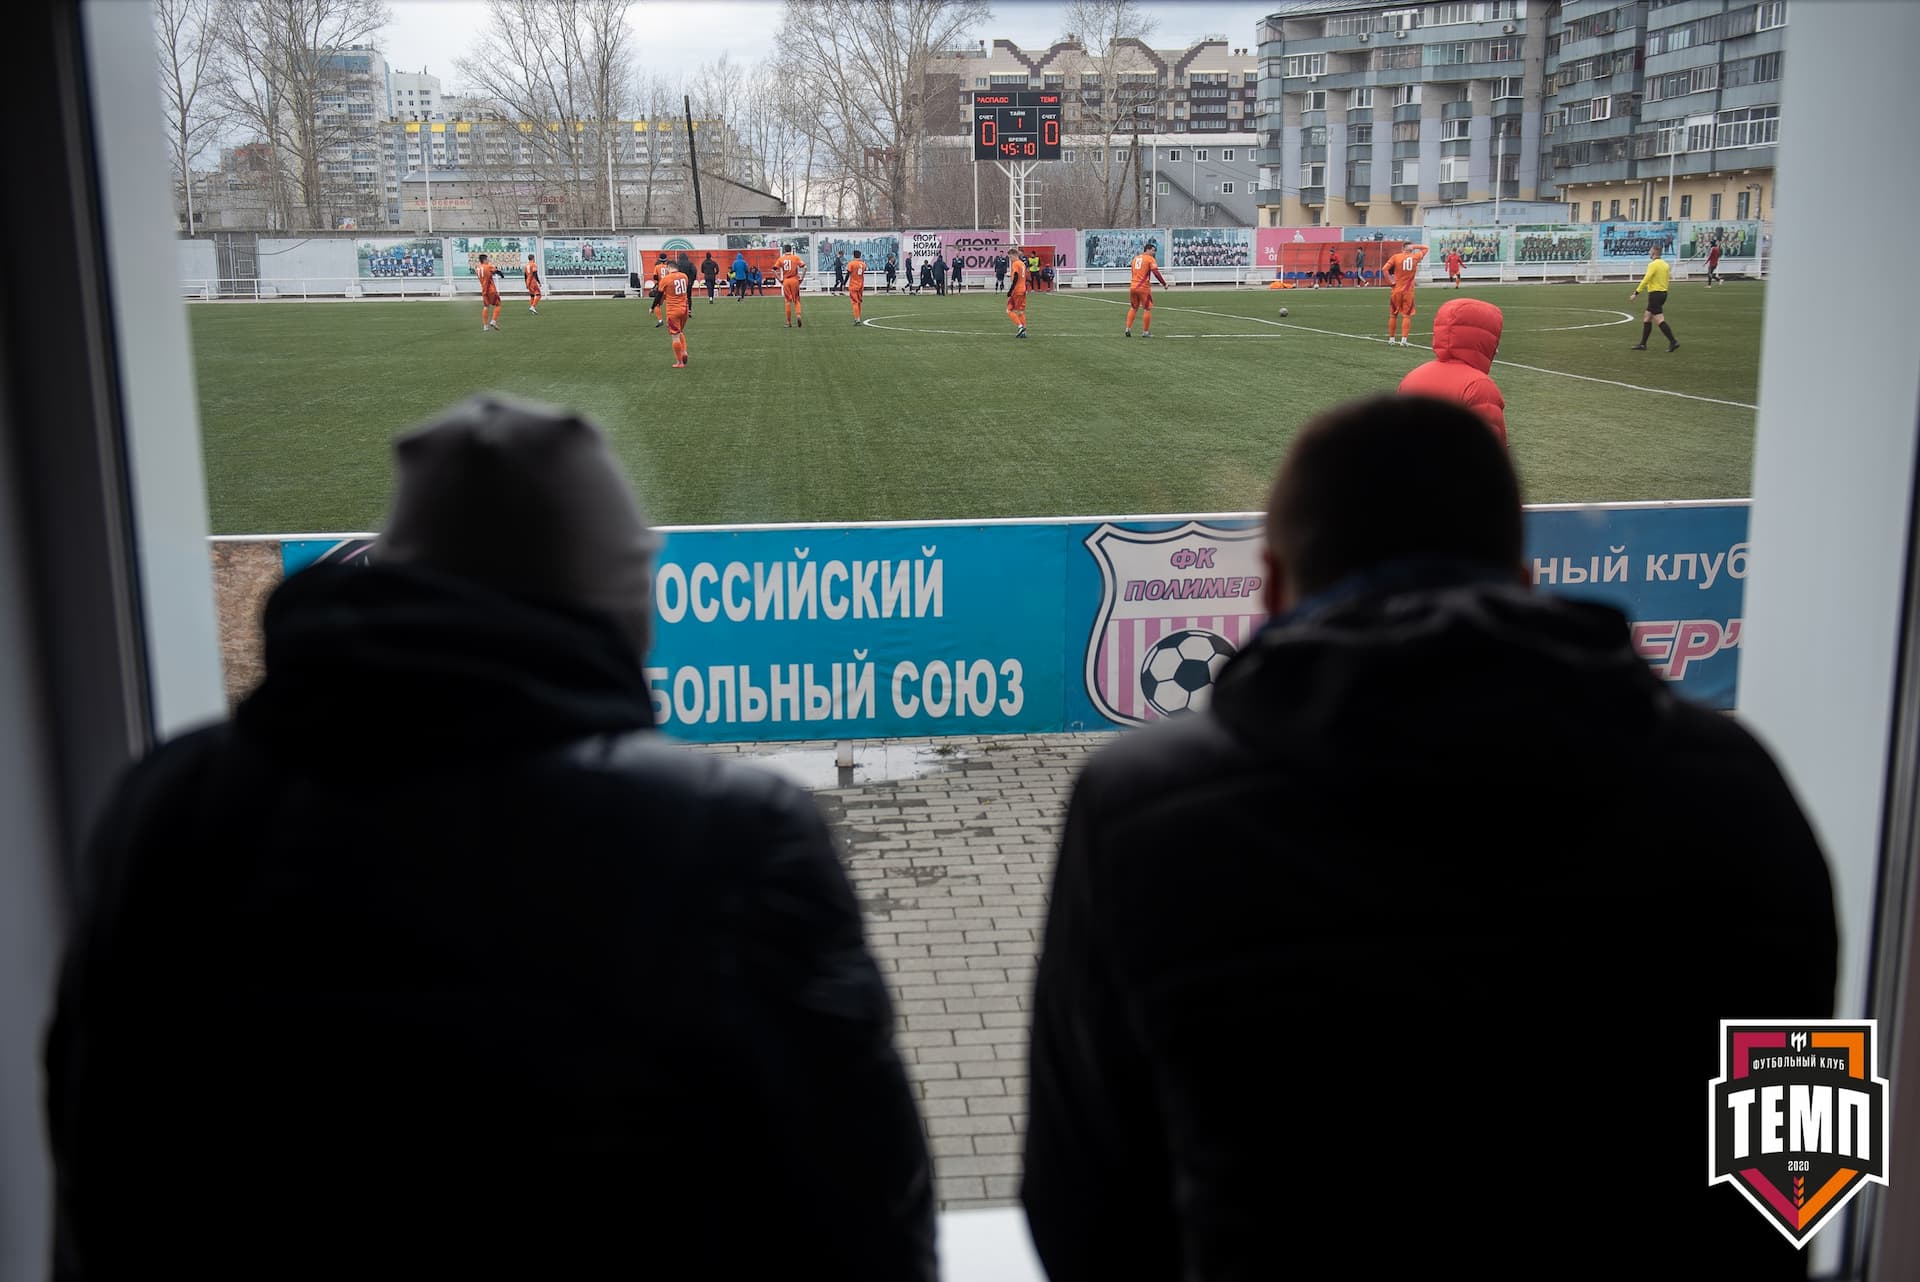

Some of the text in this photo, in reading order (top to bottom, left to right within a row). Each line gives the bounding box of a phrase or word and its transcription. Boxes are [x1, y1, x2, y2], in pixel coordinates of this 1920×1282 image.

[982, 121, 996, 146] 0
[1045, 120, 1059, 145] 0
[1000, 142, 1035, 156] 45:10
[913, 234, 937, 242] СПОРТ
[913, 242, 942, 250] НОРМА
[955, 238, 1000, 252] СПОРТ
[913, 249, 941, 257] ЖИЗНИ
[783, 260, 792, 271] 21
[673, 278, 688, 295] 20
[1170, 547, 1217, 569] ФК
[1532, 542, 1750, 590] ный клуб
[655, 545, 943, 623] ОССИЙСКИЙ
[1124, 576, 1262, 602] ПОЛИМЕР
[648, 648, 1024, 725] БОЛЬНЫЙ СОЮЗ
